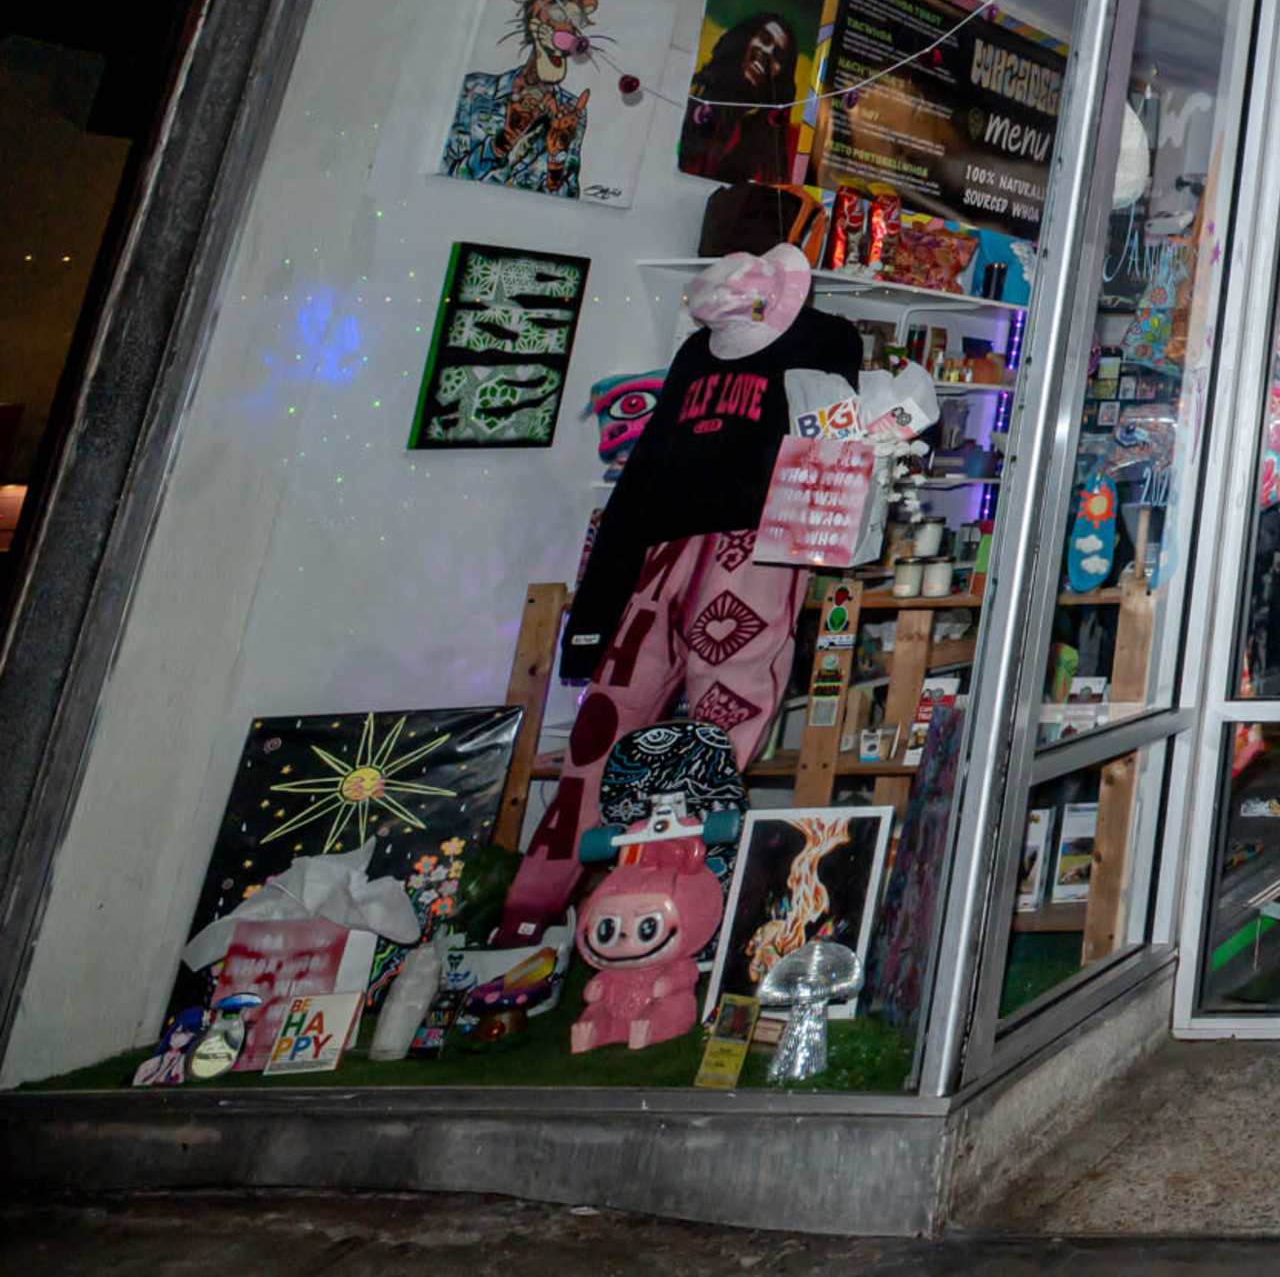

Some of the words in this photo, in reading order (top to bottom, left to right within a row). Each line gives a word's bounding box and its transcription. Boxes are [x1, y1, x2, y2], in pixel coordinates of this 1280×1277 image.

[984, 112, 1050, 162] menu
[966, 164, 996, 186] 100%
[963, 188, 1009, 214] SOURCED
[679, 375, 719, 422] ELF
[716, 373, 769, 422] LOVE
[282, 1011, 324, 1037] HA
[271, 1034, 333, 1063] PPY
